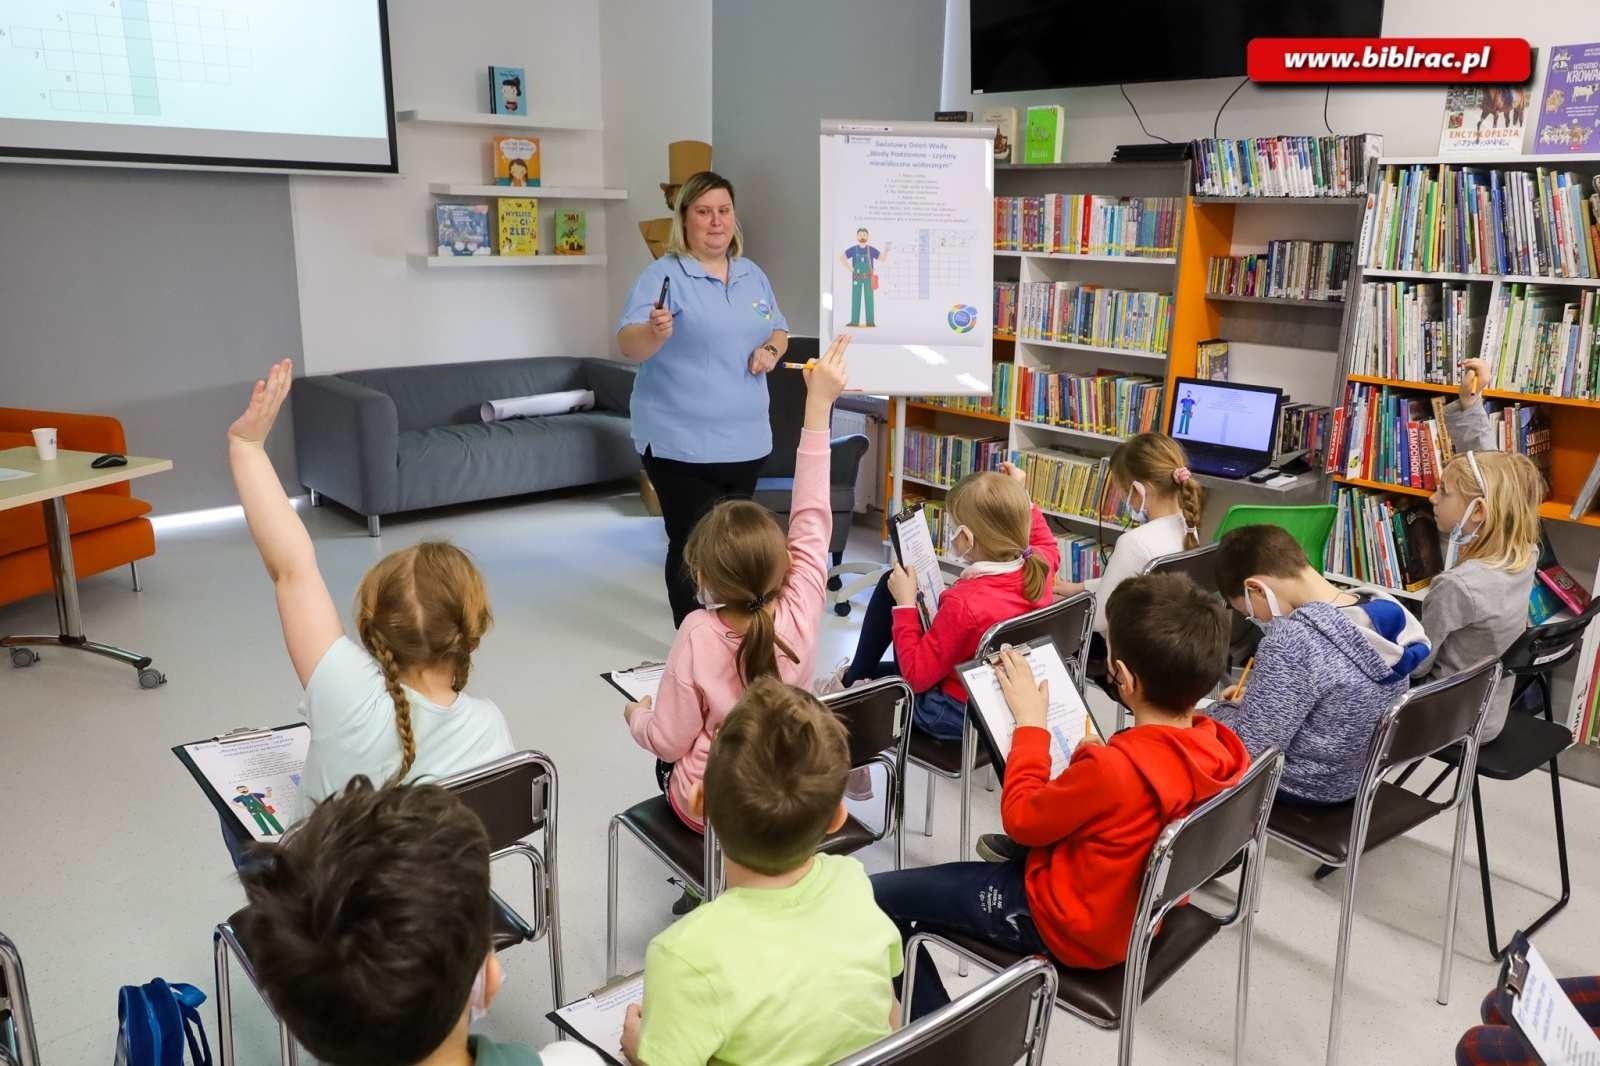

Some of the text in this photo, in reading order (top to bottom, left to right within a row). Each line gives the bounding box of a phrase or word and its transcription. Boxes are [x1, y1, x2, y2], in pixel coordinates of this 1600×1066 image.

[875, 140, 907, 149] Światowy
[1450, 130, 1519, 138] ENCYKLOPEDIA
[1482, 318, 1494, 362] OŚLINY
[1330, 420, 1338, 460] POJAZDY
[1408, 428, 1420, 482] SAMOCHODY
[1420, 430, 1432, 475] MOTOCYKLE
